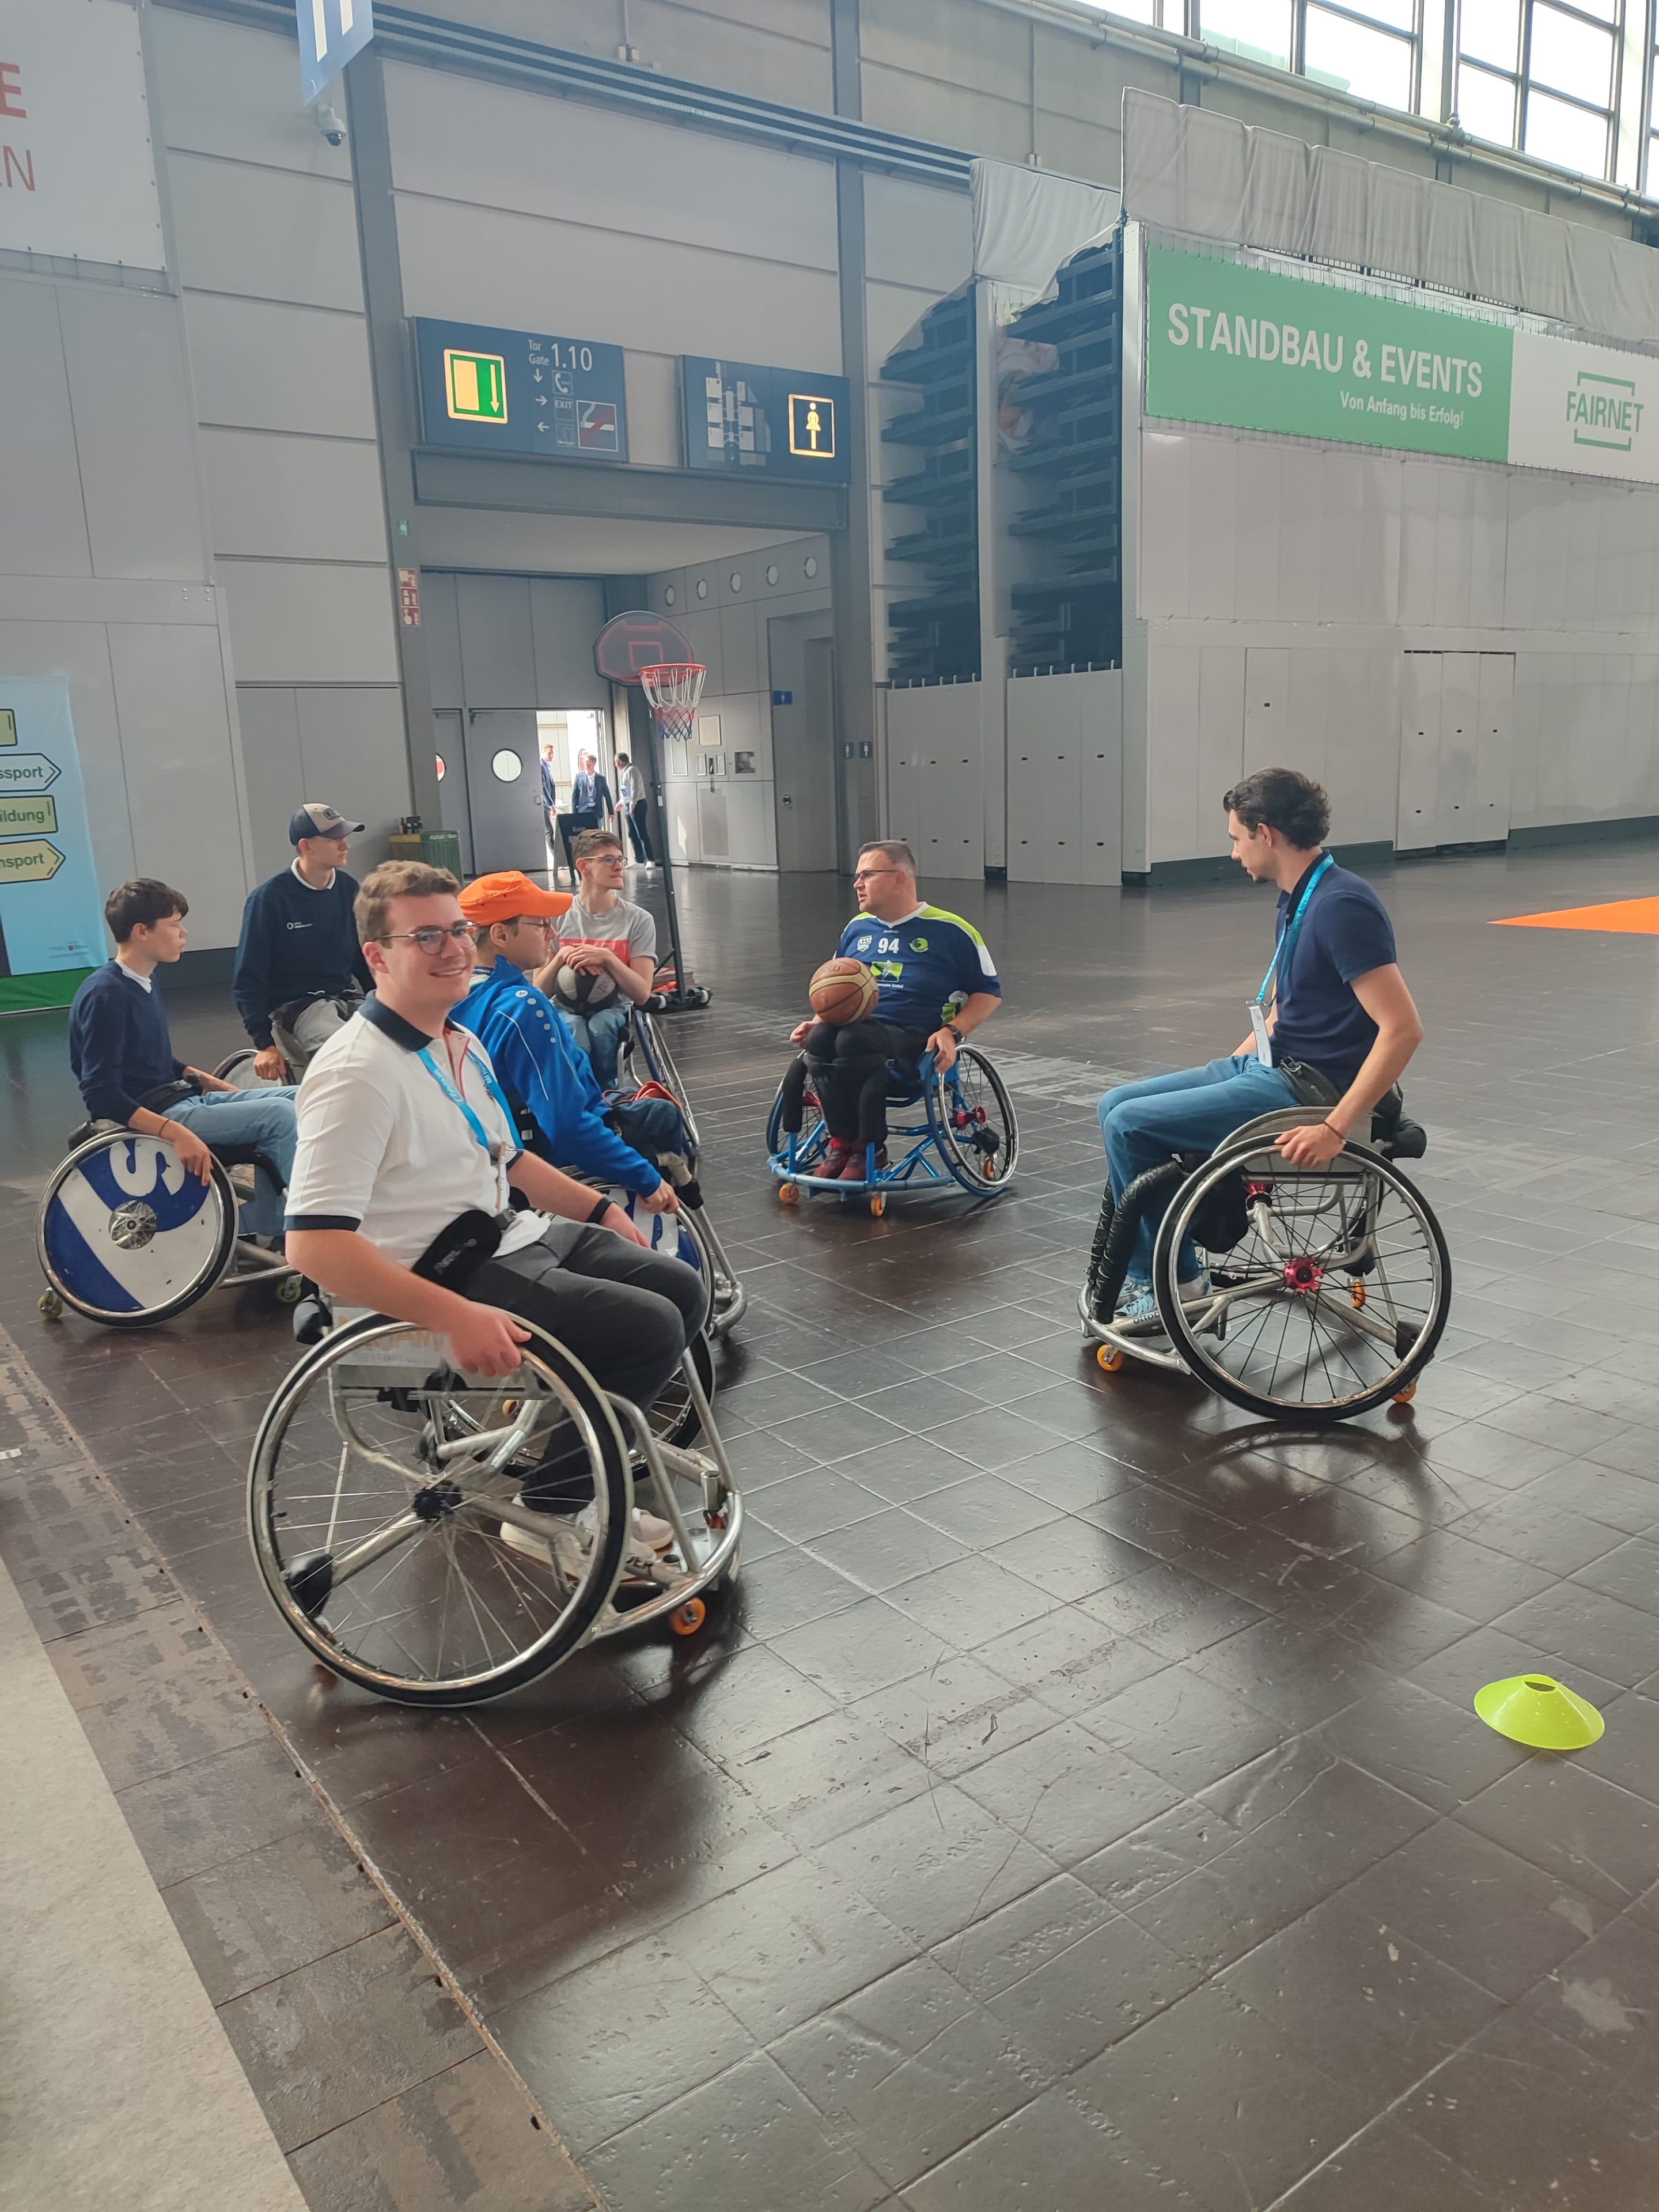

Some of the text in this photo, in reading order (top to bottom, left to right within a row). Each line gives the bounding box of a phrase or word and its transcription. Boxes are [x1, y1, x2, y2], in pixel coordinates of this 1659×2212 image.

[528, 339, 541, 351] Tor
[1168, 302, 1483, 397] STANDBAU & EVENTS
[529, 353, 550, 366] Gate
[551, 343, 593, 372] 1.10
[555, 399, 573, 410] EXIT
[1340, 390, 1464, 429] Von Anfang bis Erfolg!
[1566, 390, 1645, 433] FAIRNET
[877, 938, 900, 954] 94
